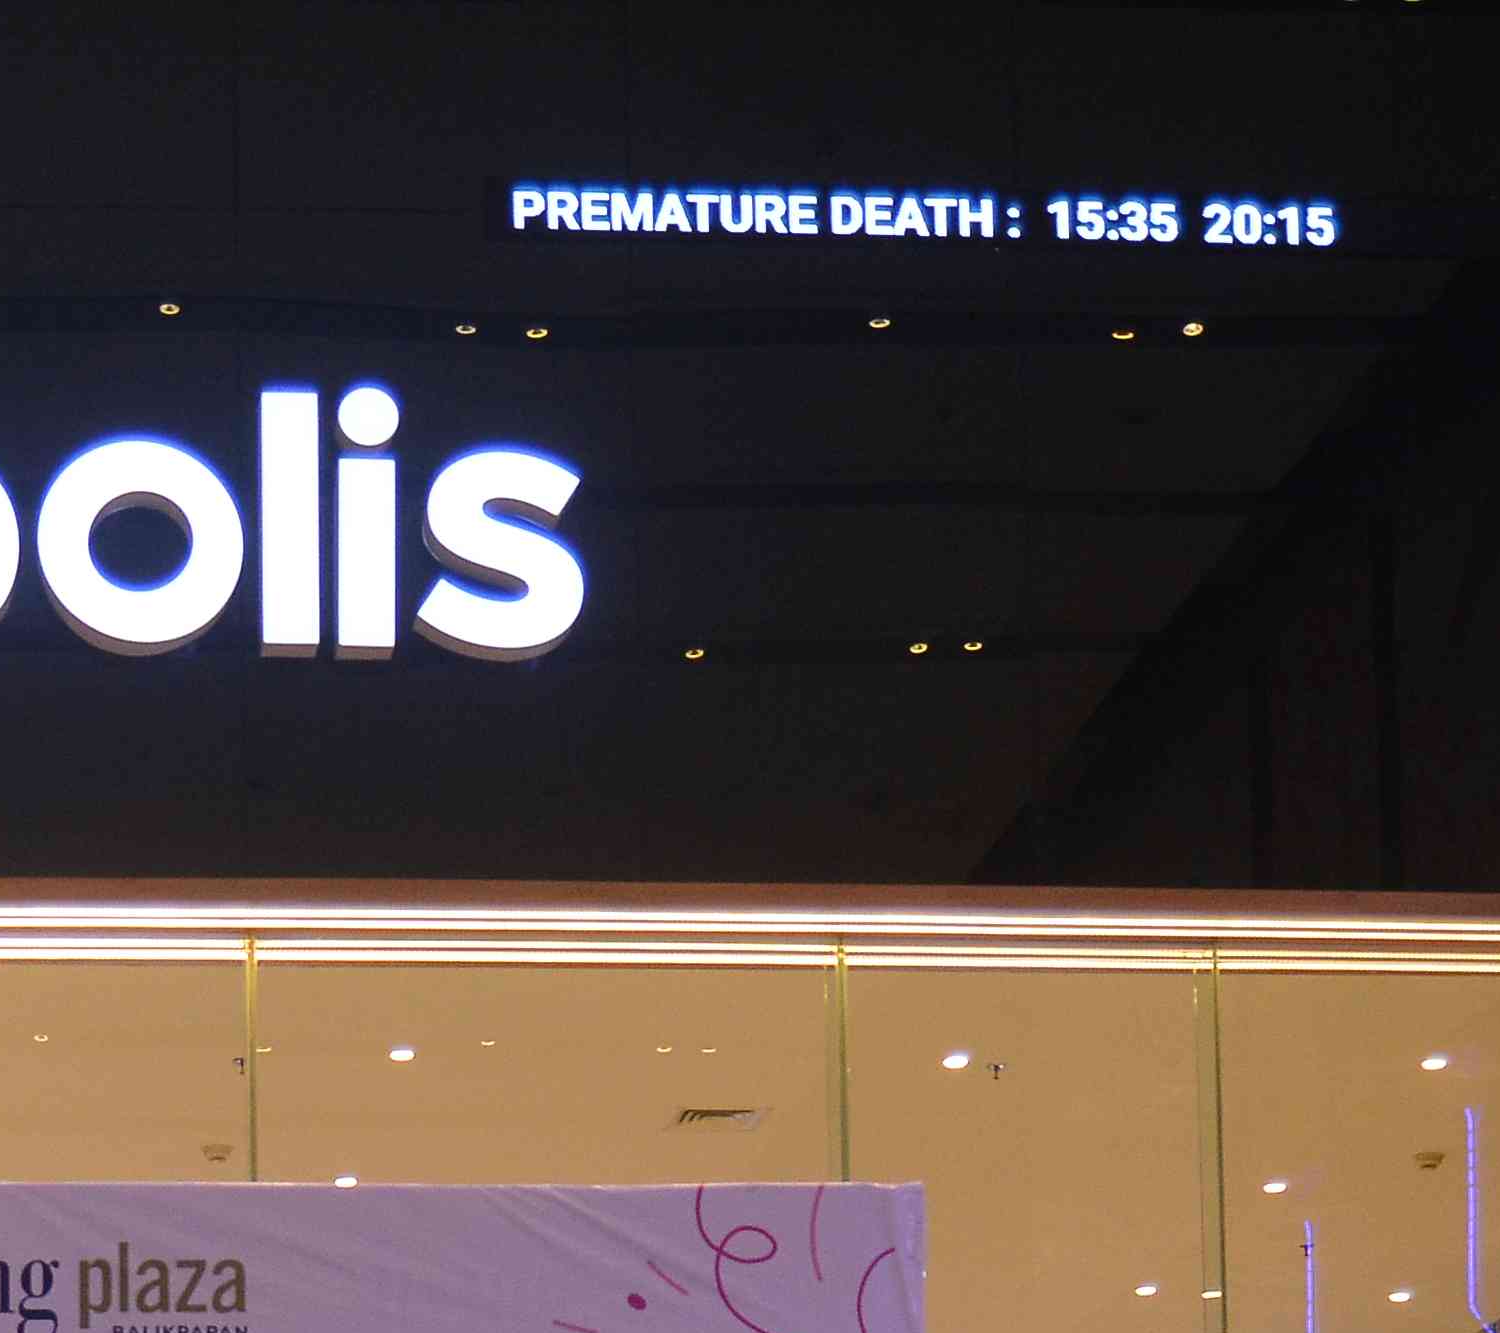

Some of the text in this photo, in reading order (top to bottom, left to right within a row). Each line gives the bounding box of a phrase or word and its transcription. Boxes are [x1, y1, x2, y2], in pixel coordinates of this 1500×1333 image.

[511, 189, 819, 235] PREMATURE
[1047, 199, 1179, 243] 15:35
[1202, 202, 1336, 246] 20:15
[78, 1241, 249, 1329] plaza
